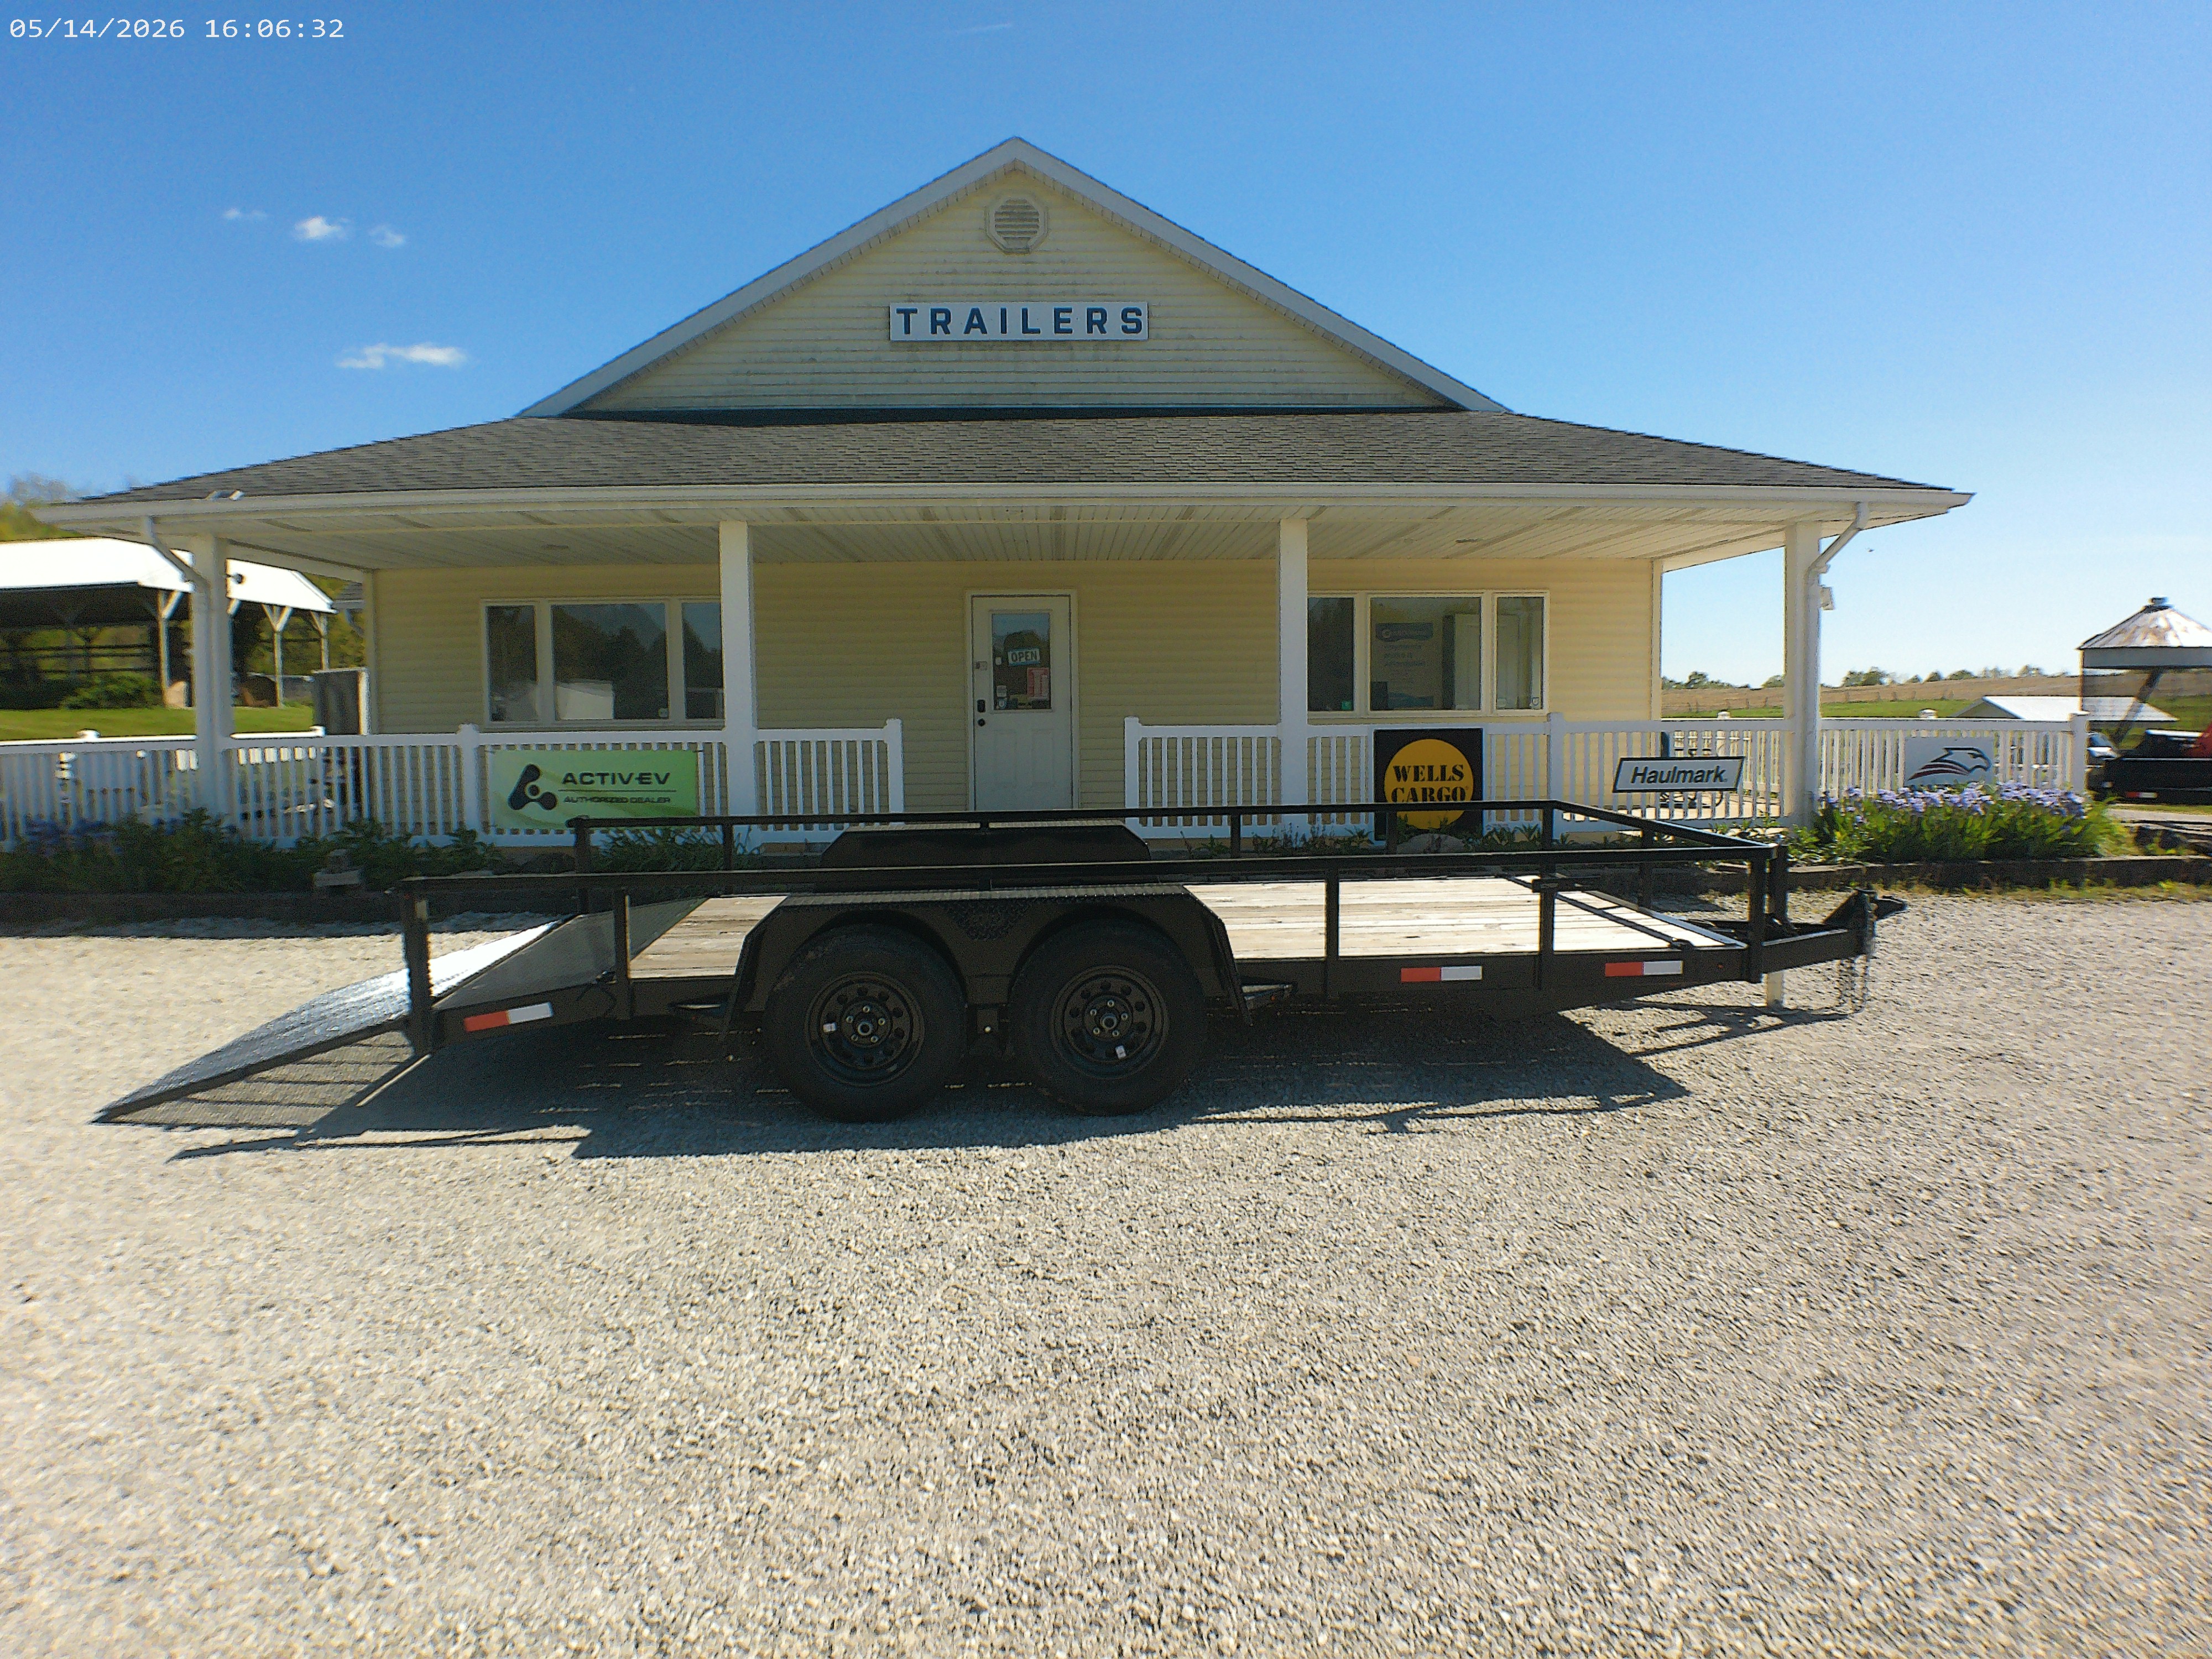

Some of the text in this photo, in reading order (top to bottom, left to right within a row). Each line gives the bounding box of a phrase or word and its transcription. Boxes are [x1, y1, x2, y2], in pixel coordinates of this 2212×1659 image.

[896, 307, 1142, 335] TRAILERS
[1010, 650, 1037, 662] OPEN
[1393, 764, 1464, 782] WELLS
[1630, 765, 1726, 784] Haulmark
[1391, 786, 1466, 802] CARGO
